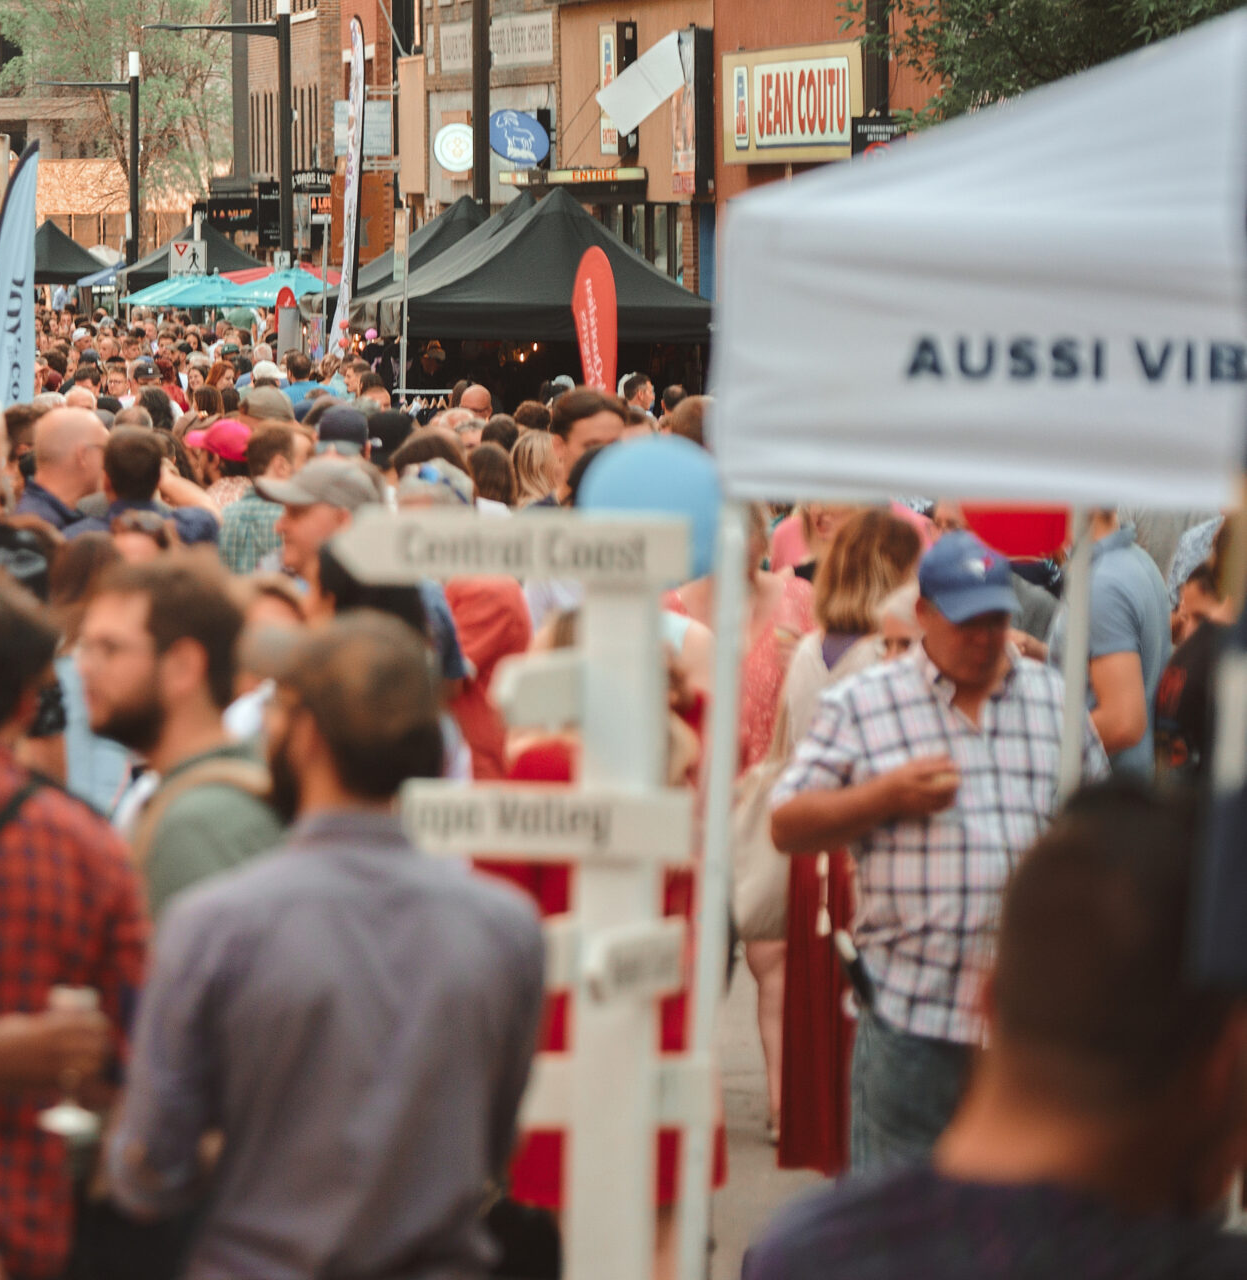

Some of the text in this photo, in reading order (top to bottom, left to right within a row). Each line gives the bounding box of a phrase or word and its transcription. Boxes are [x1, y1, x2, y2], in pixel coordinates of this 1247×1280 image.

[757, 67, 846, 139] JEAN COUTU
[907, 336, 1102, 380] AUSSI
[397, 523, 649, 569] Central Coast
[496, 797, 609, 846] Valley
